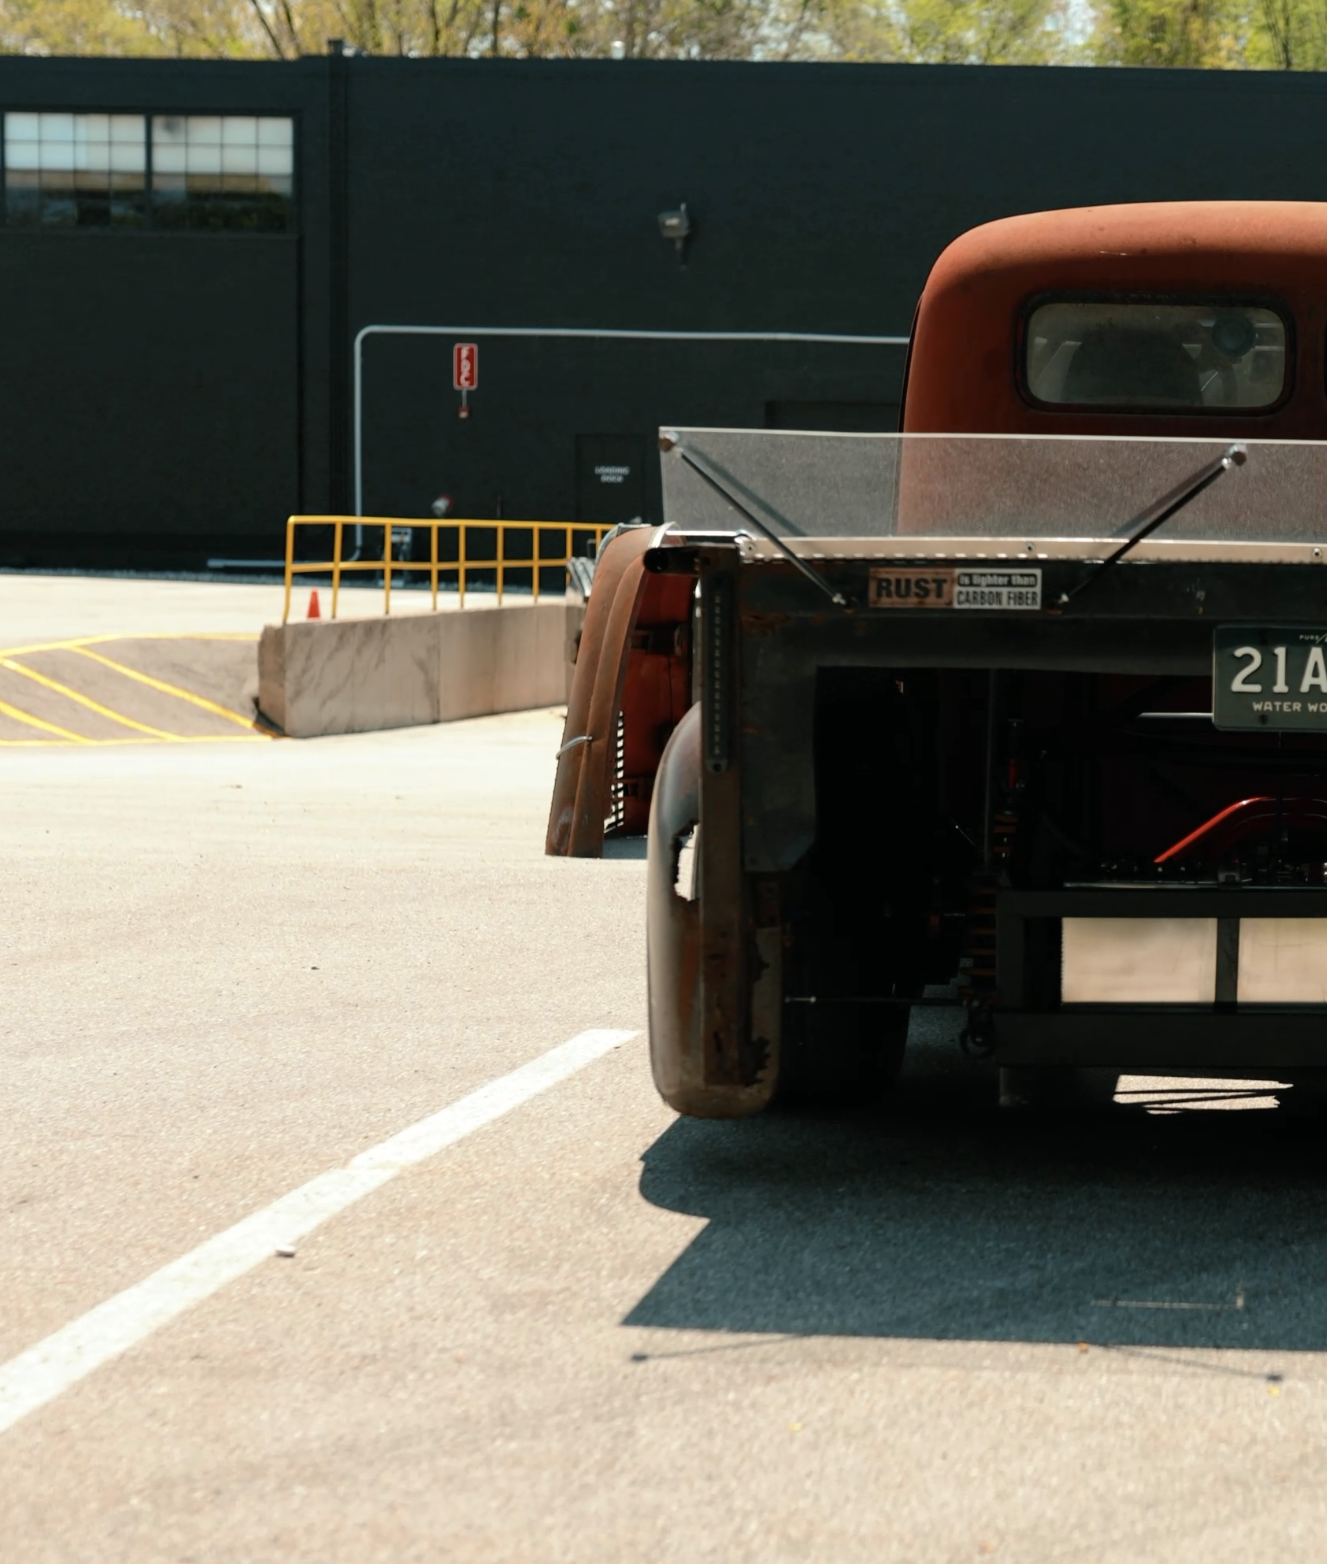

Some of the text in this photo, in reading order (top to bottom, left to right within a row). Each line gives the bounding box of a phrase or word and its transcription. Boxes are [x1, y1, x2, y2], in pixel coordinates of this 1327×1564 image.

[460, 346, 471, 388] FDC
[594, 466, 630, 475] LOADING
[600, 475, 623, 484] DOCK
[959, 573, 1036, 588] is lighter than
[875, 577, 948, 599] RUST
[957, 590, 1038, 606] CARBON FIBER
[1299, 633, 1320, 641] PURE
[1252, 701, 1302, 712] WATER
